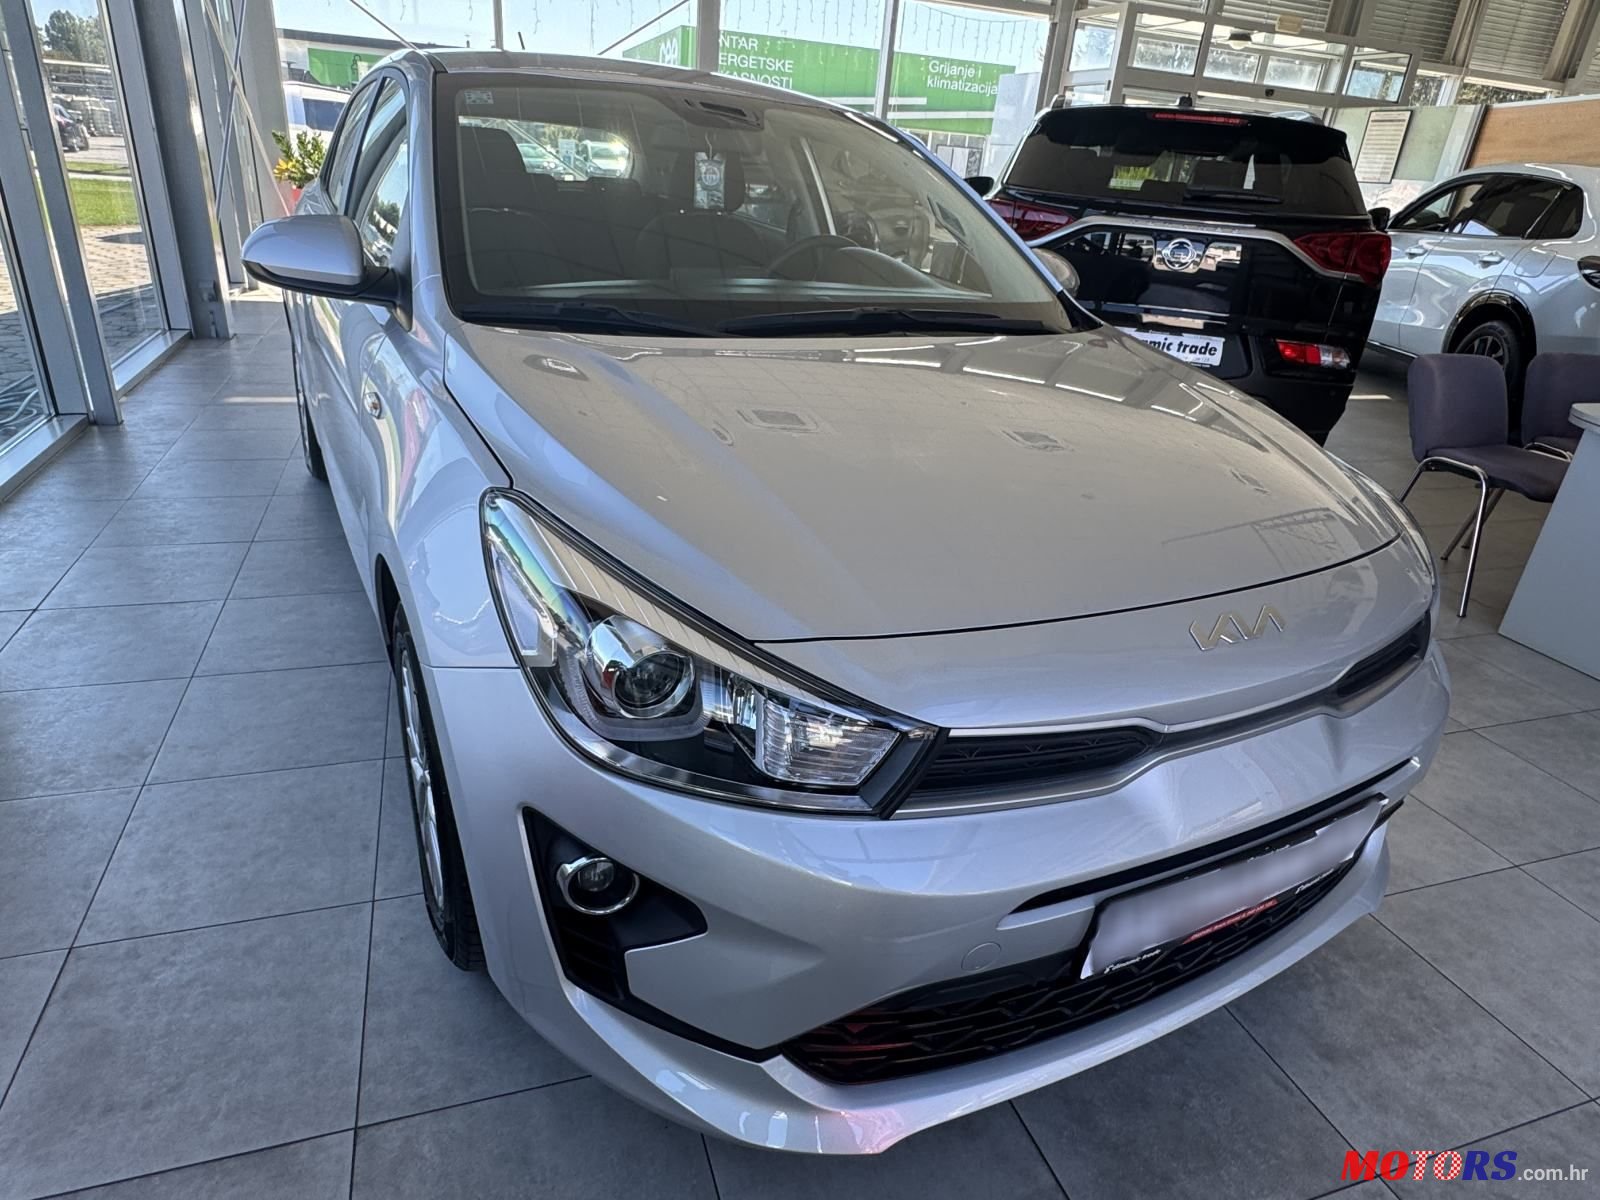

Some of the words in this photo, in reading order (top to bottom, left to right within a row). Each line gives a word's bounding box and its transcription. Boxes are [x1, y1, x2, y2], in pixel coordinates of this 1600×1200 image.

[719, 53, 794, 73] ERGETSKE
[928, 60, 976, 80] Grijanje
[978, 65, 982, 79] i
[927, 75, 999, 97] klimatizacija
[1145, 336, 1173, 352] mic
[1177, 340, 1218, 357] trade
